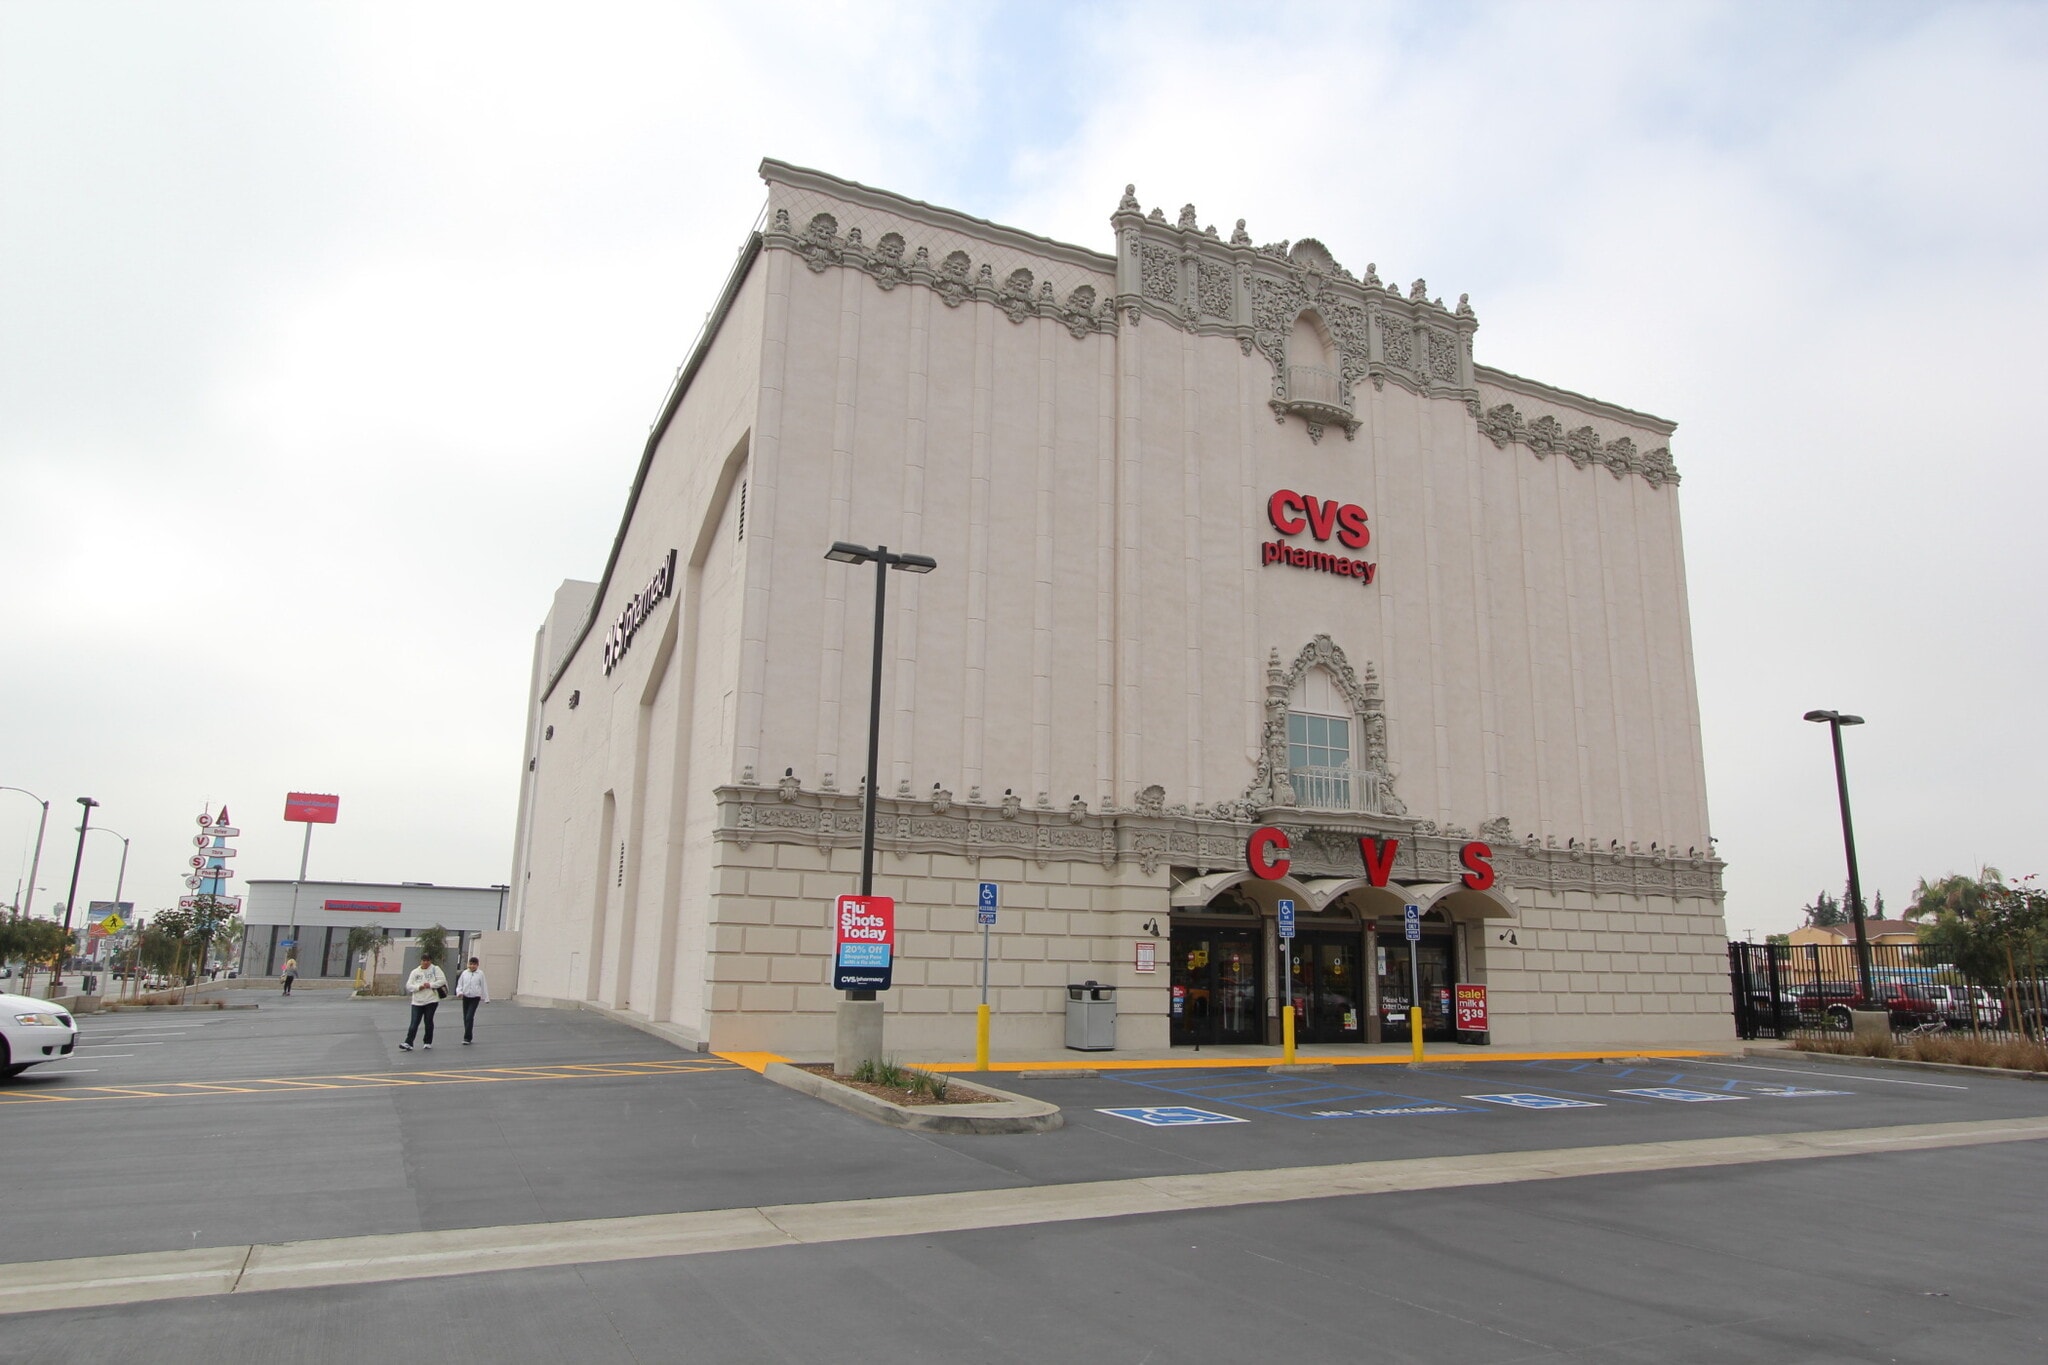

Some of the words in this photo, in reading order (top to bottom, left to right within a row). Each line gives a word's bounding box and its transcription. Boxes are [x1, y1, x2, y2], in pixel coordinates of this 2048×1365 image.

[1268, 489, 1370, 549] CVS
[1262, 539, 1376, 585] pharmacy
[842, 901, 865, 914] Flu
[841, 913, 884, 926] Shots
[842, 926, 886, 941] Today
[844, 945, 867, 954] 20%
[868, 945, 883, 954] Off
[1458, 989, 1485, 999] sale!
[1459, 1000, 1477, 1008] milk
